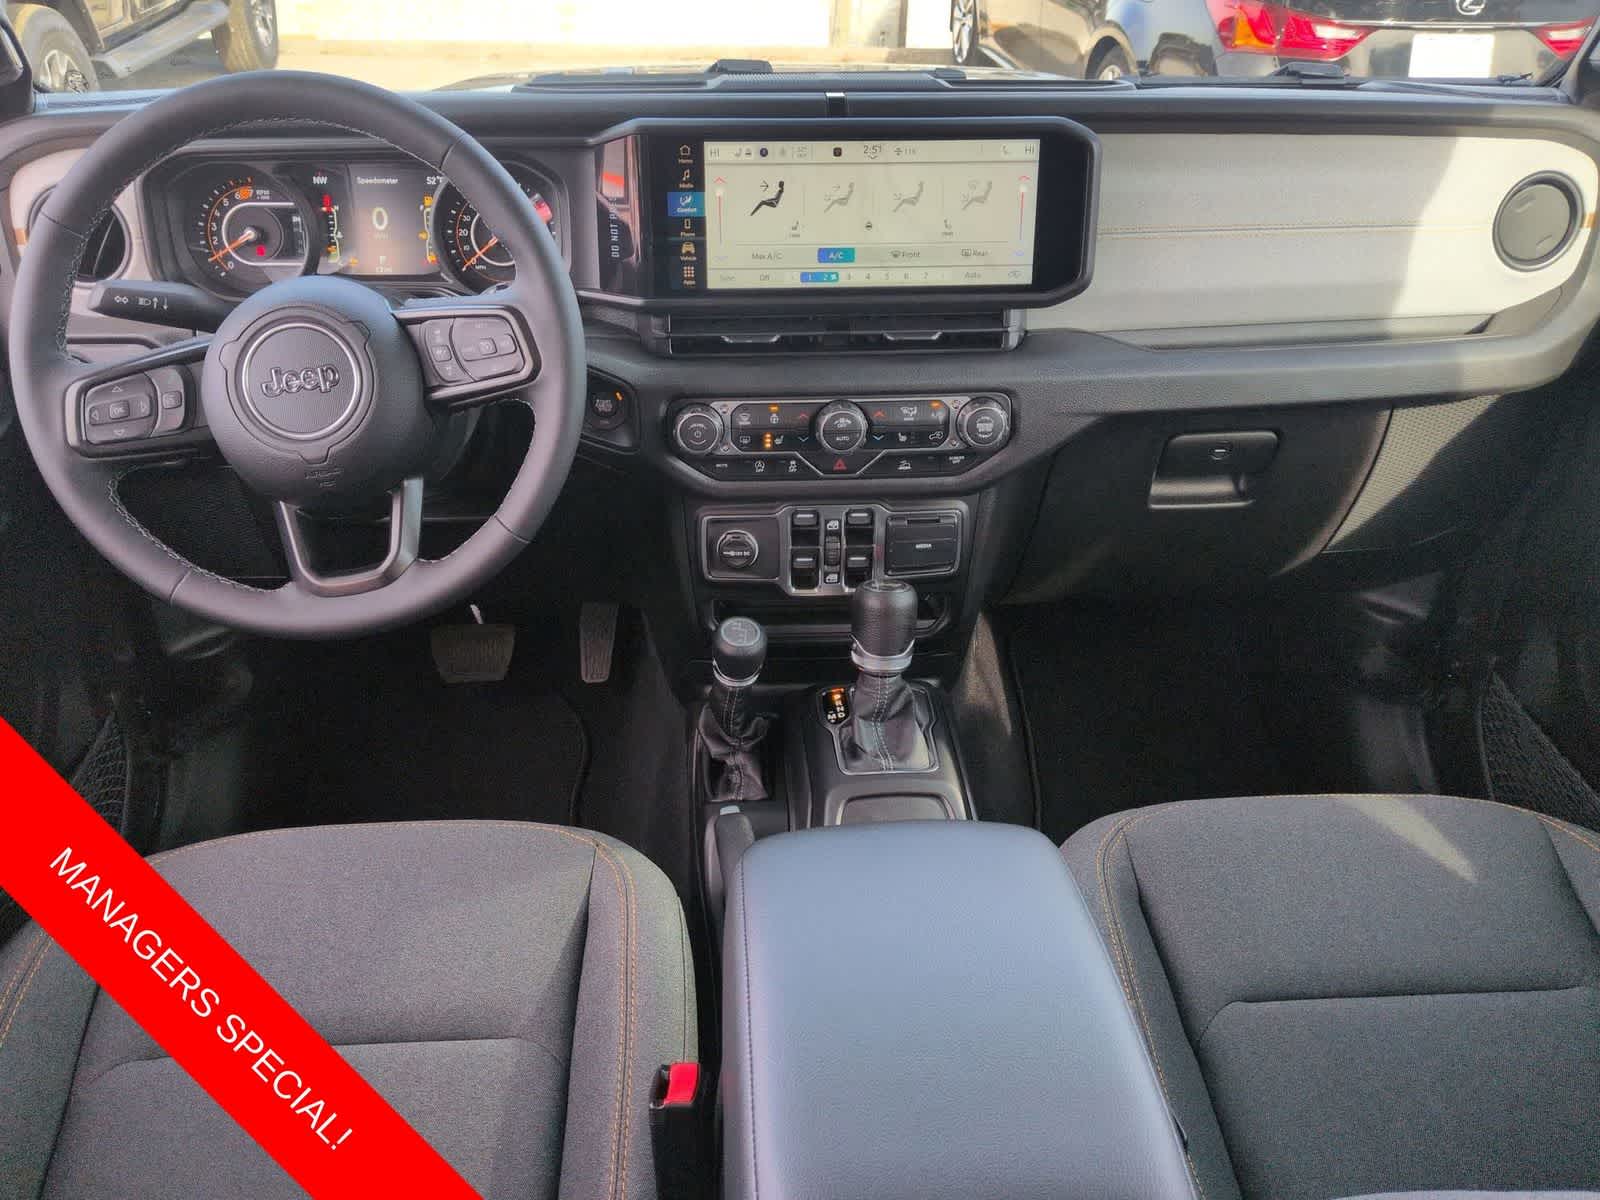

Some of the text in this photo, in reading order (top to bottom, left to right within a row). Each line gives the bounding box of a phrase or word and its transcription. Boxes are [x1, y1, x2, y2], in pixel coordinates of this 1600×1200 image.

[863, 145, 882, 154] 2:51
[313, 176, 328, 185] NW
[356, 176, 398, 186] Speedometer
[372, 207, 389, 231] 0
[458, 229, 469, 237] 20
[609, 224, 619, 242] NOT
[610, 245, 620, 258] DO
[829, 252, 844, 260] A/C
[261, 362, 340, 398] Jeep
